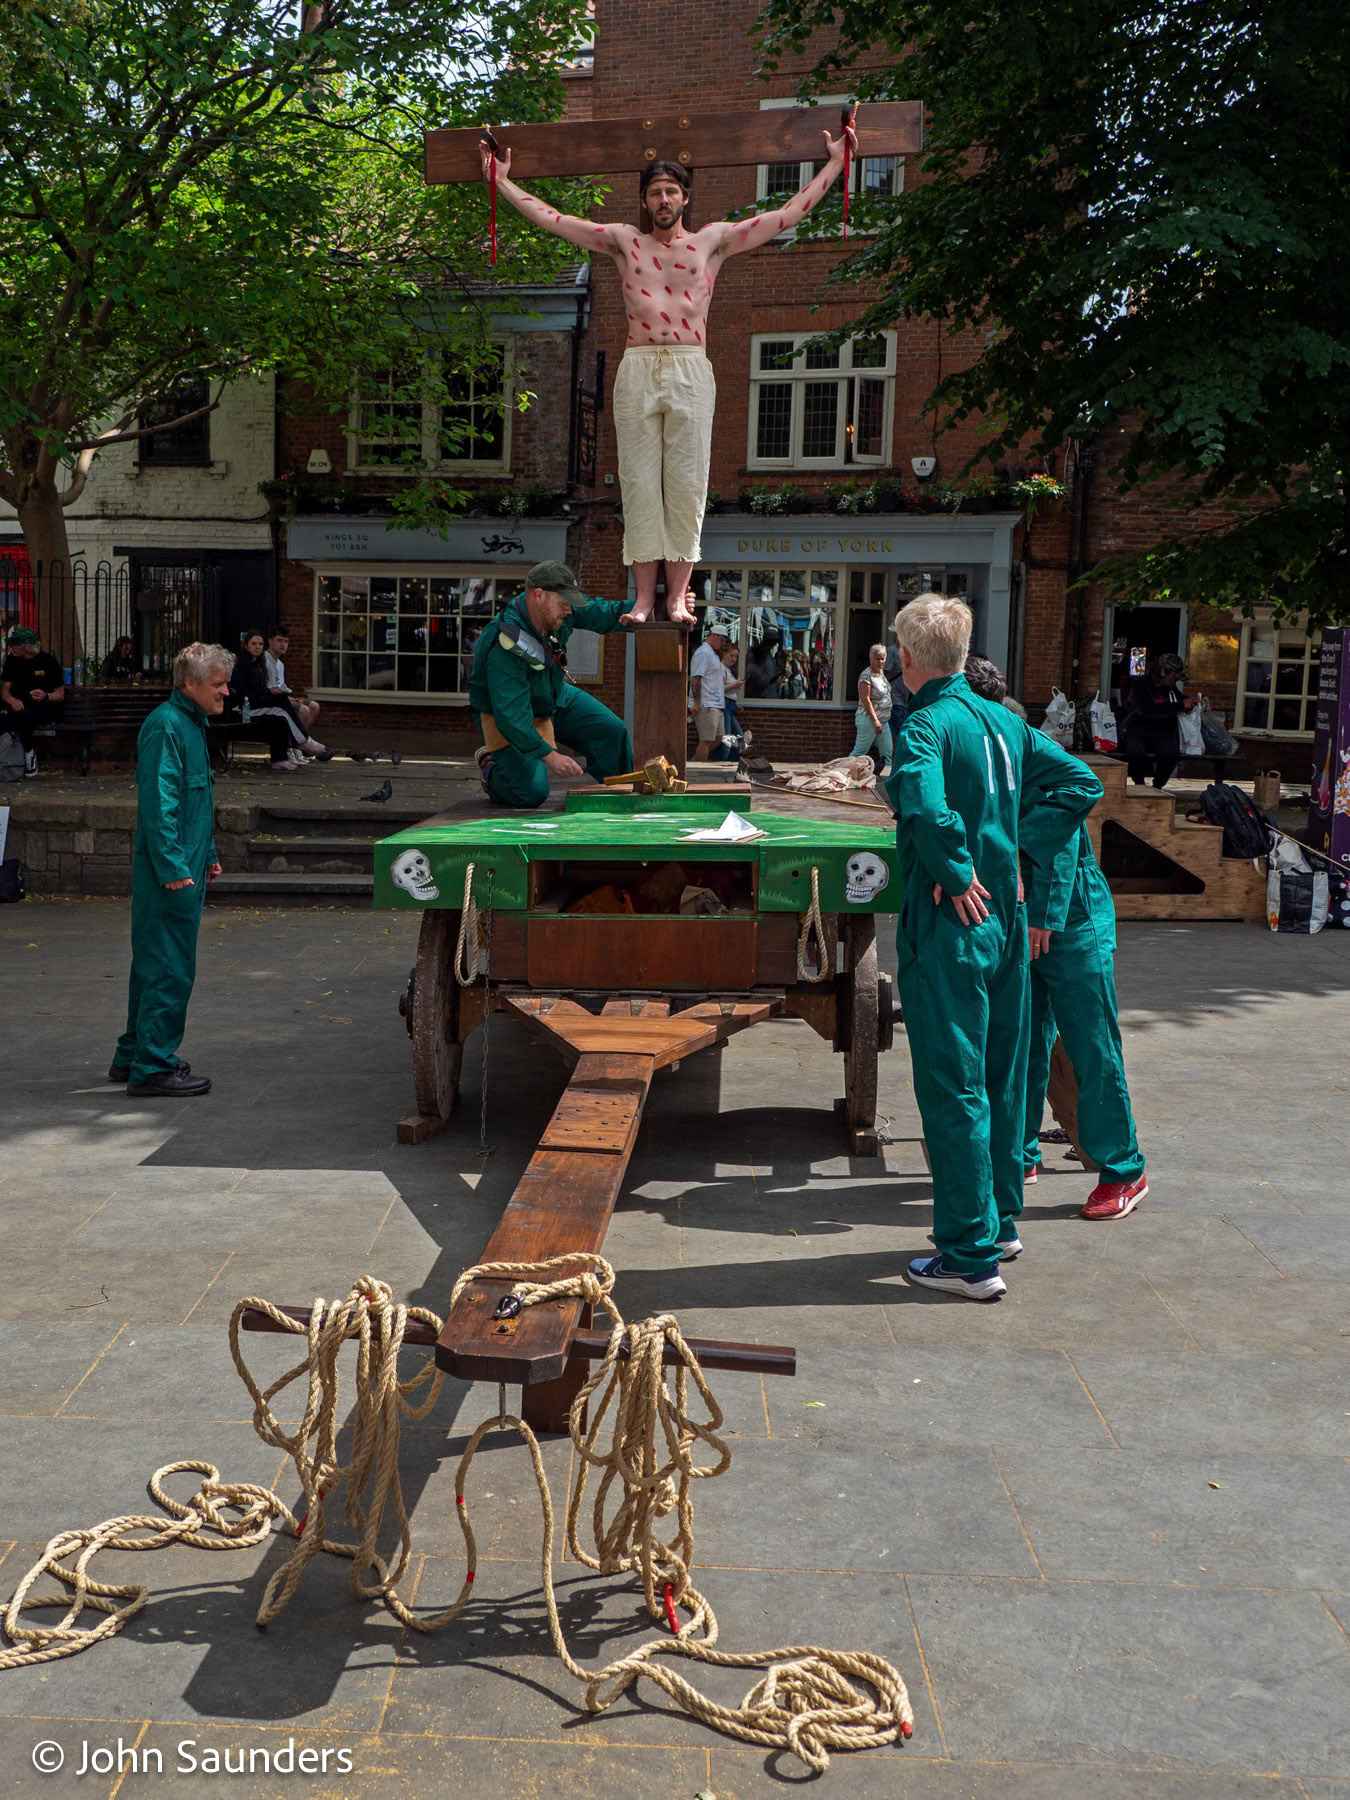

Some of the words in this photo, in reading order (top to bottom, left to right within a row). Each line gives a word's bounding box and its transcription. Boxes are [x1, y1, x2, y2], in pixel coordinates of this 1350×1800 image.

[738, 539, 792, 552] DUKE
[801, 539, 828, 552] OF
[838, 539, 894, 552] YORK
